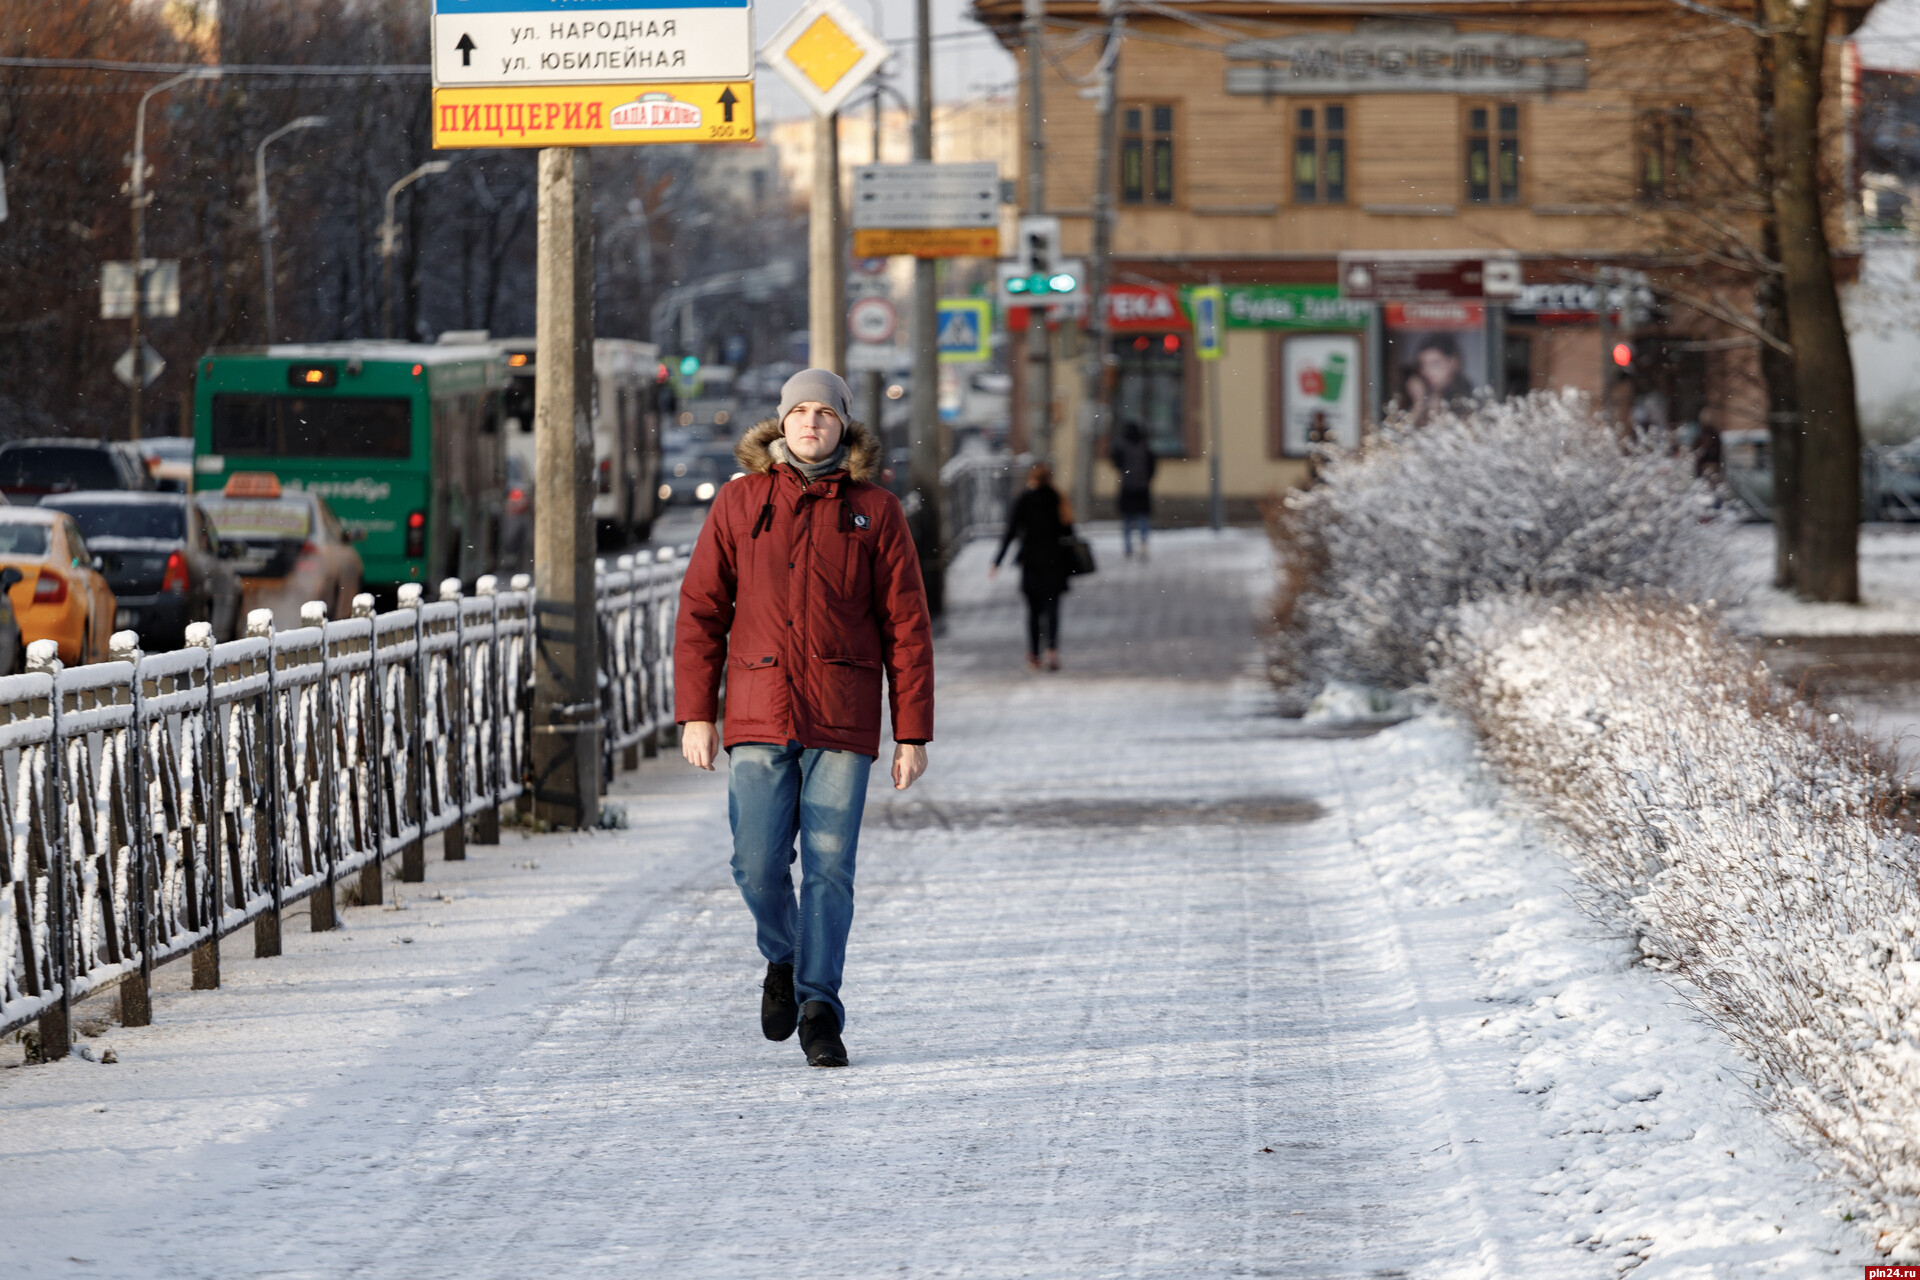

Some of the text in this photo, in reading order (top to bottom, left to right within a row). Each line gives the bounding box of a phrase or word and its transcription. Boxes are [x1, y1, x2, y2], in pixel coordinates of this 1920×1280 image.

[511, 19, 676, 45] ул. НАРОДНАЯ
[502, 45, 685, 75] ул. ЮБИЛЕЙНАЯ
[1290, 42, 1522, 80] МЕБЕЛЬ
[439, 102, 603, 138] ПИЦЦЕРИЯ
[709, 125, 735, 138] 300
